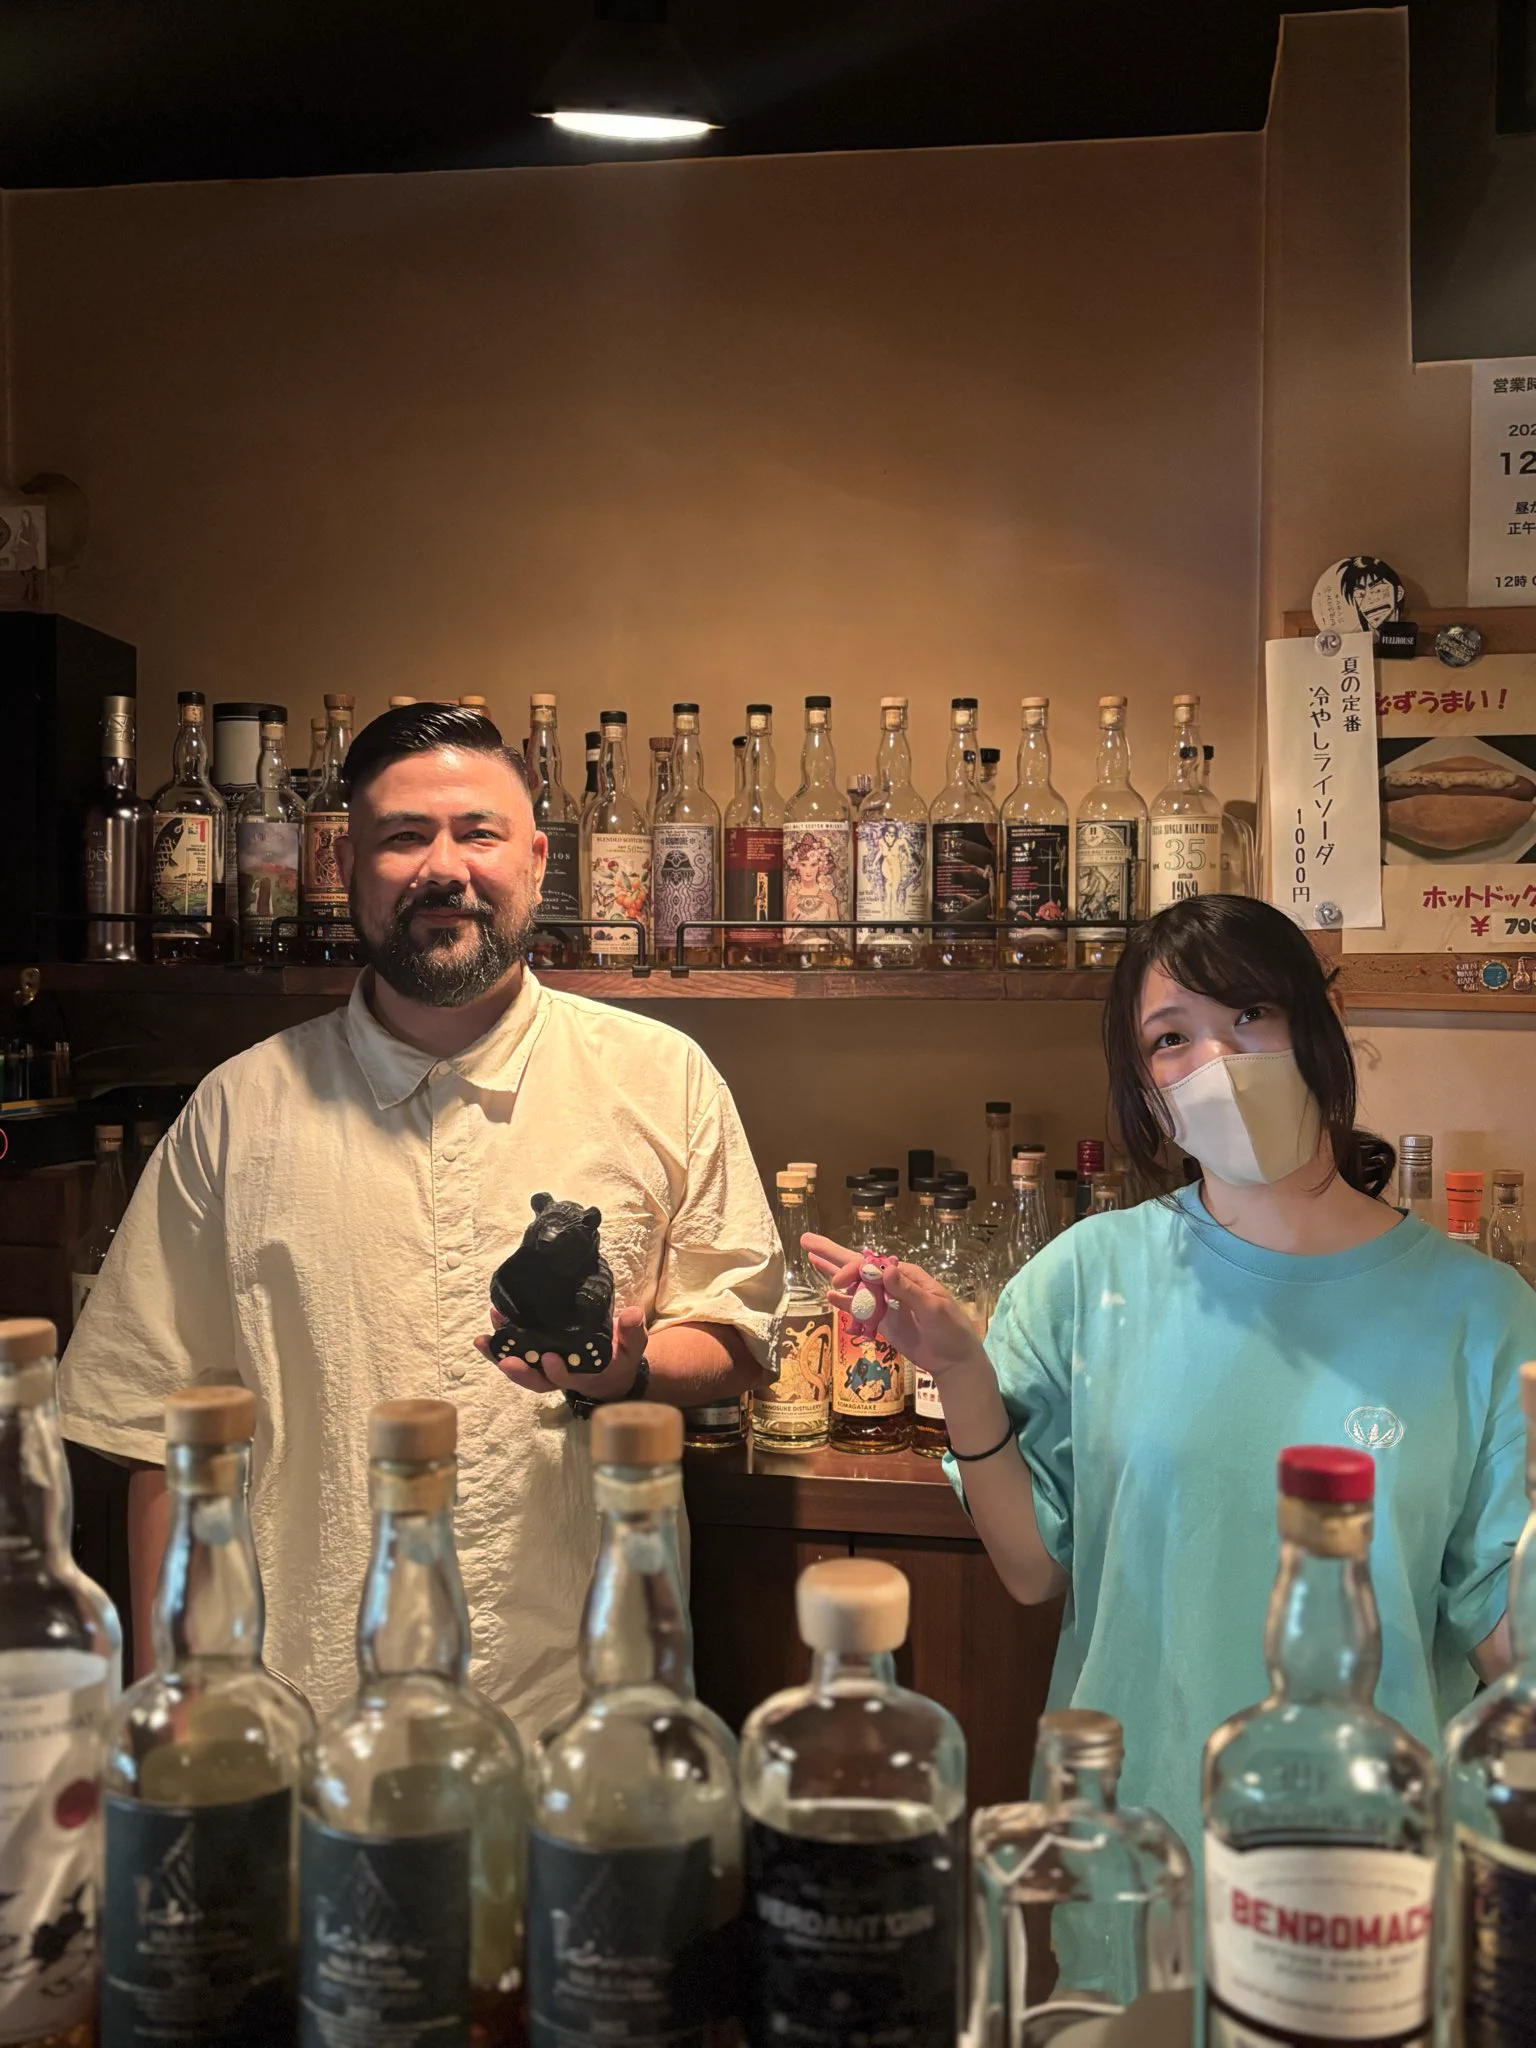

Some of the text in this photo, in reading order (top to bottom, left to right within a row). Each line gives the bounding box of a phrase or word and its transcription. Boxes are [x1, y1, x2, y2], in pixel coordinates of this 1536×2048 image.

[1500, 450, 1536, 475] 12
[1340, 656, 1362, 733] 夏の定番
[1309, 685, 1335, 866] 冷やしライソーダ
[1164, 823, 1183, 834] SINGLE
[1185, 823, 1199, 834] MALT
[1164, 838, 1207, 871] 35
[1292, 808, 1310, 903] 1000円
[1171, 881, 1199, 900] 1989
[1470, 915, 1491, 937] ¥
[1463, 1222, 1475, 1233] 12
[761, 1404, 821, 1412] KANOSUKE DISTILLERY
[837, 1401, 877, 1411] KOMAGATAKE
